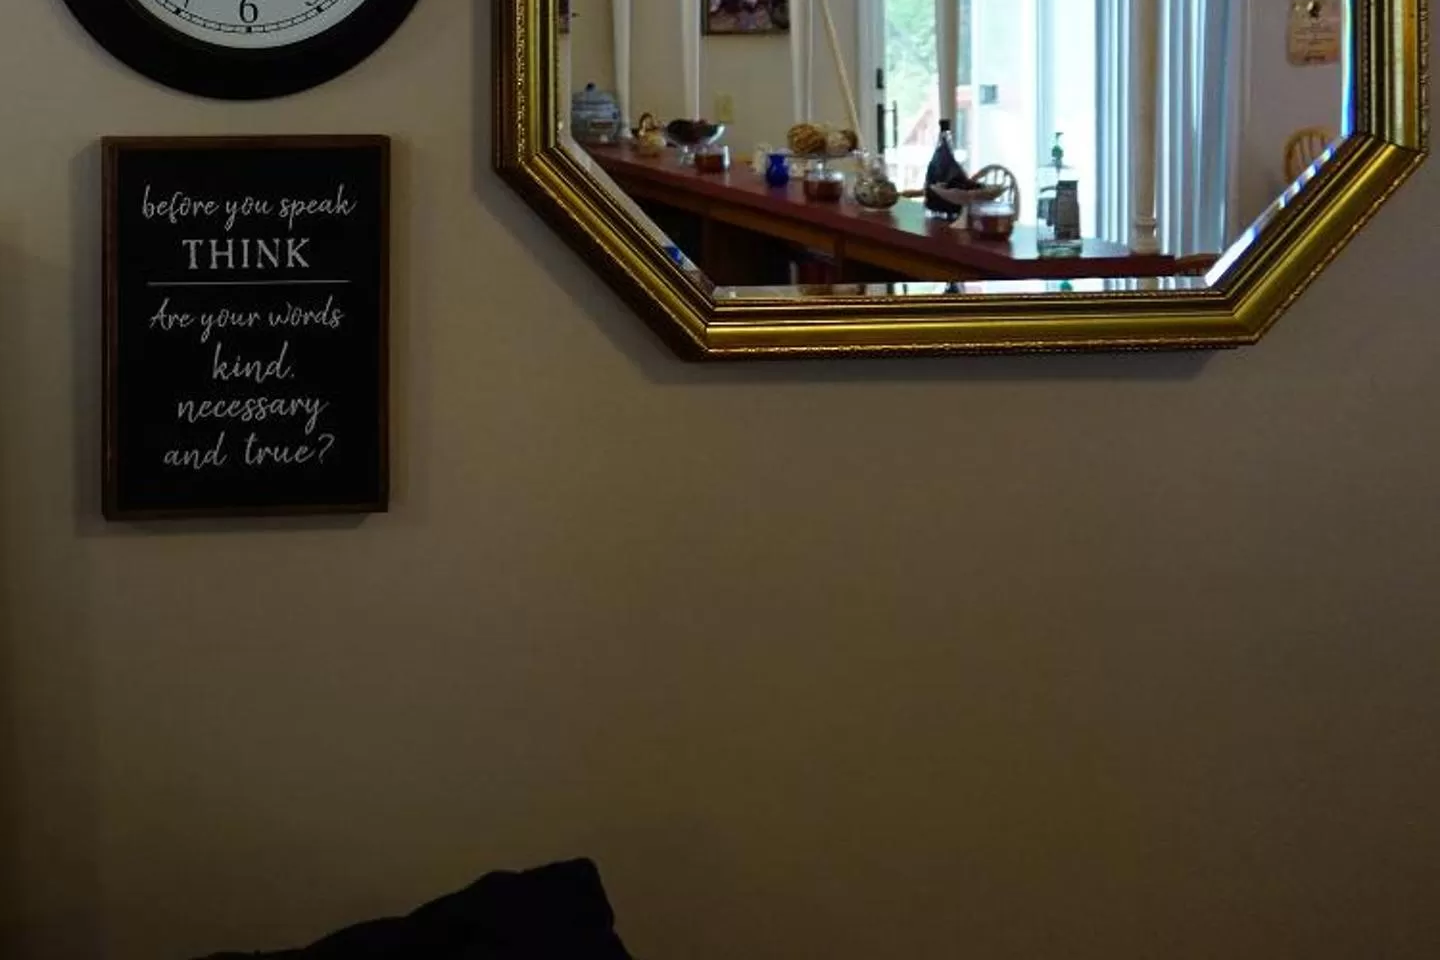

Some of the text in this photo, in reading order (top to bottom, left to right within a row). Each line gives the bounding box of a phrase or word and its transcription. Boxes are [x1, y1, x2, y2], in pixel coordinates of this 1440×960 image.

[142, 183, 357, 231] before you speak
[182, 238, 310, 270] THINK
[149, 294, 344, 343] Are your words
[177, 396, 331, 436] necessary
[163, 431, 336, 470] and true?
